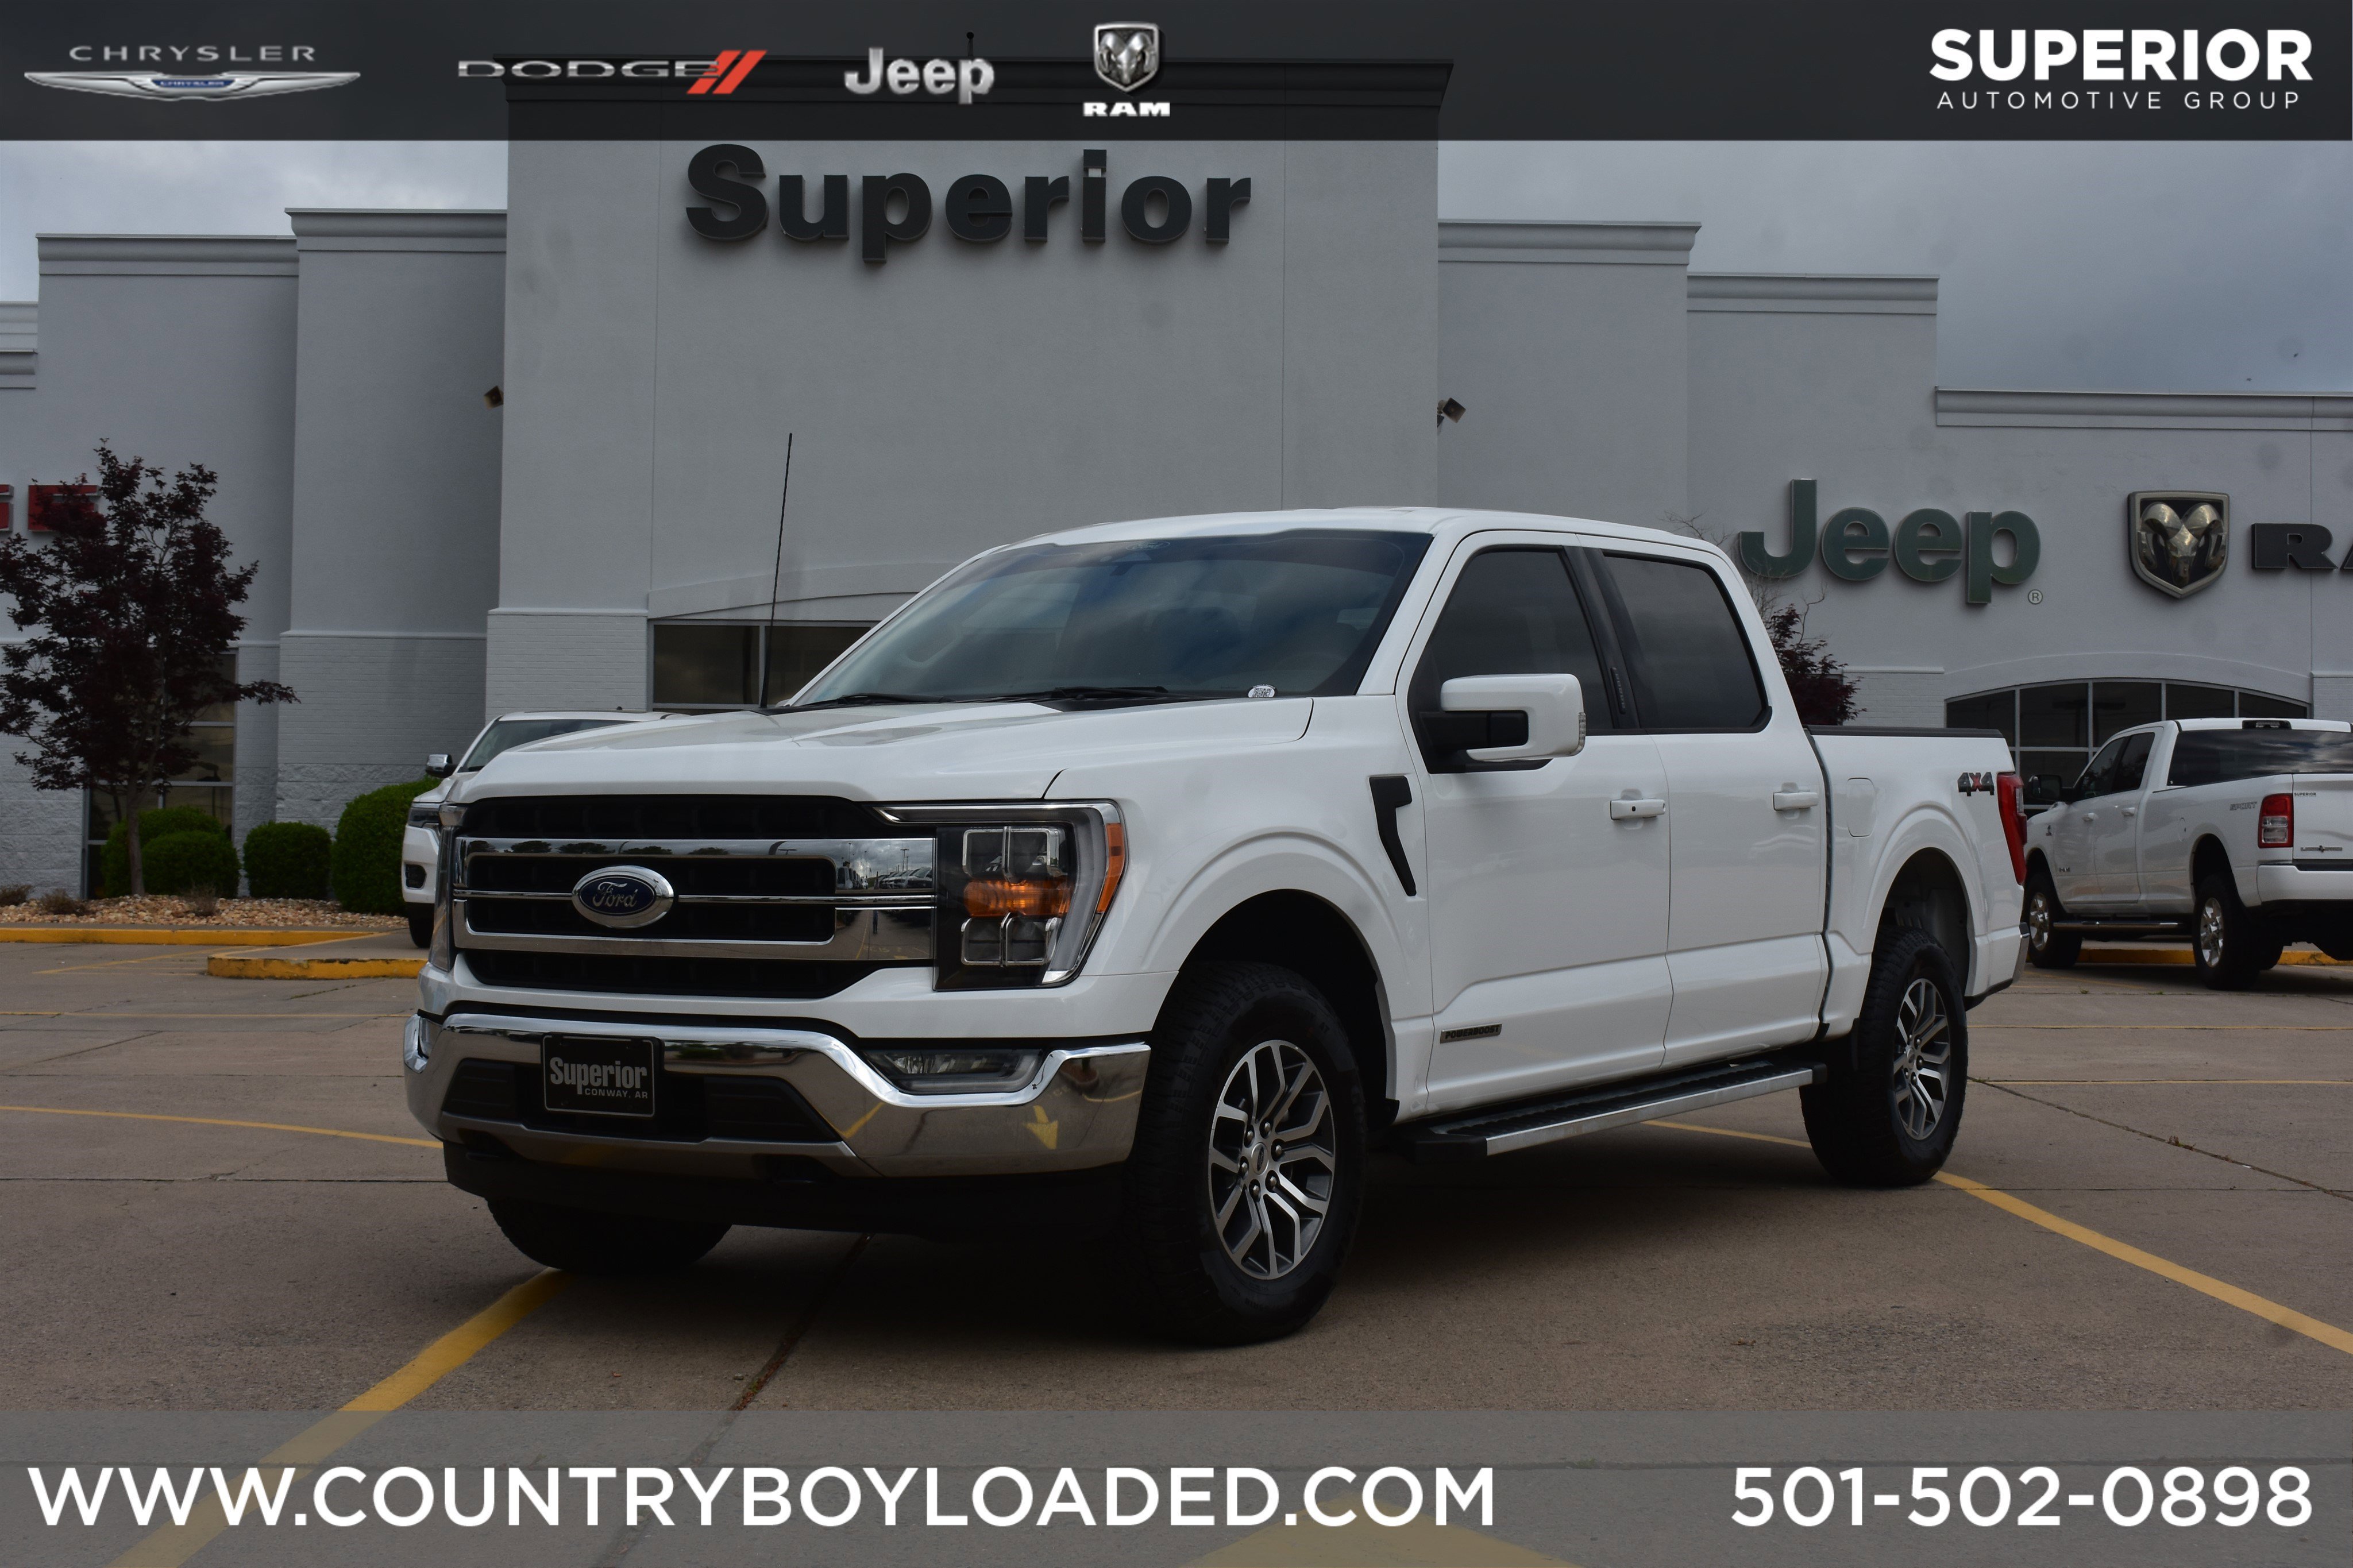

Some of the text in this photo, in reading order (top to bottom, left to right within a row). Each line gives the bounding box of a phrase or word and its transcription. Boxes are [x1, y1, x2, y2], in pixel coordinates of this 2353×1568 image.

[685, 144, 1251, 263] Superior
[1738, 478, 2041, 604] Jeep
[2251, 523, 2353, 569] R
[592, 881, 639, 907] Ford
[549, 1056, 647, 1095] Superior
[585, 1088, 649, 1099] CONWAY, AR
